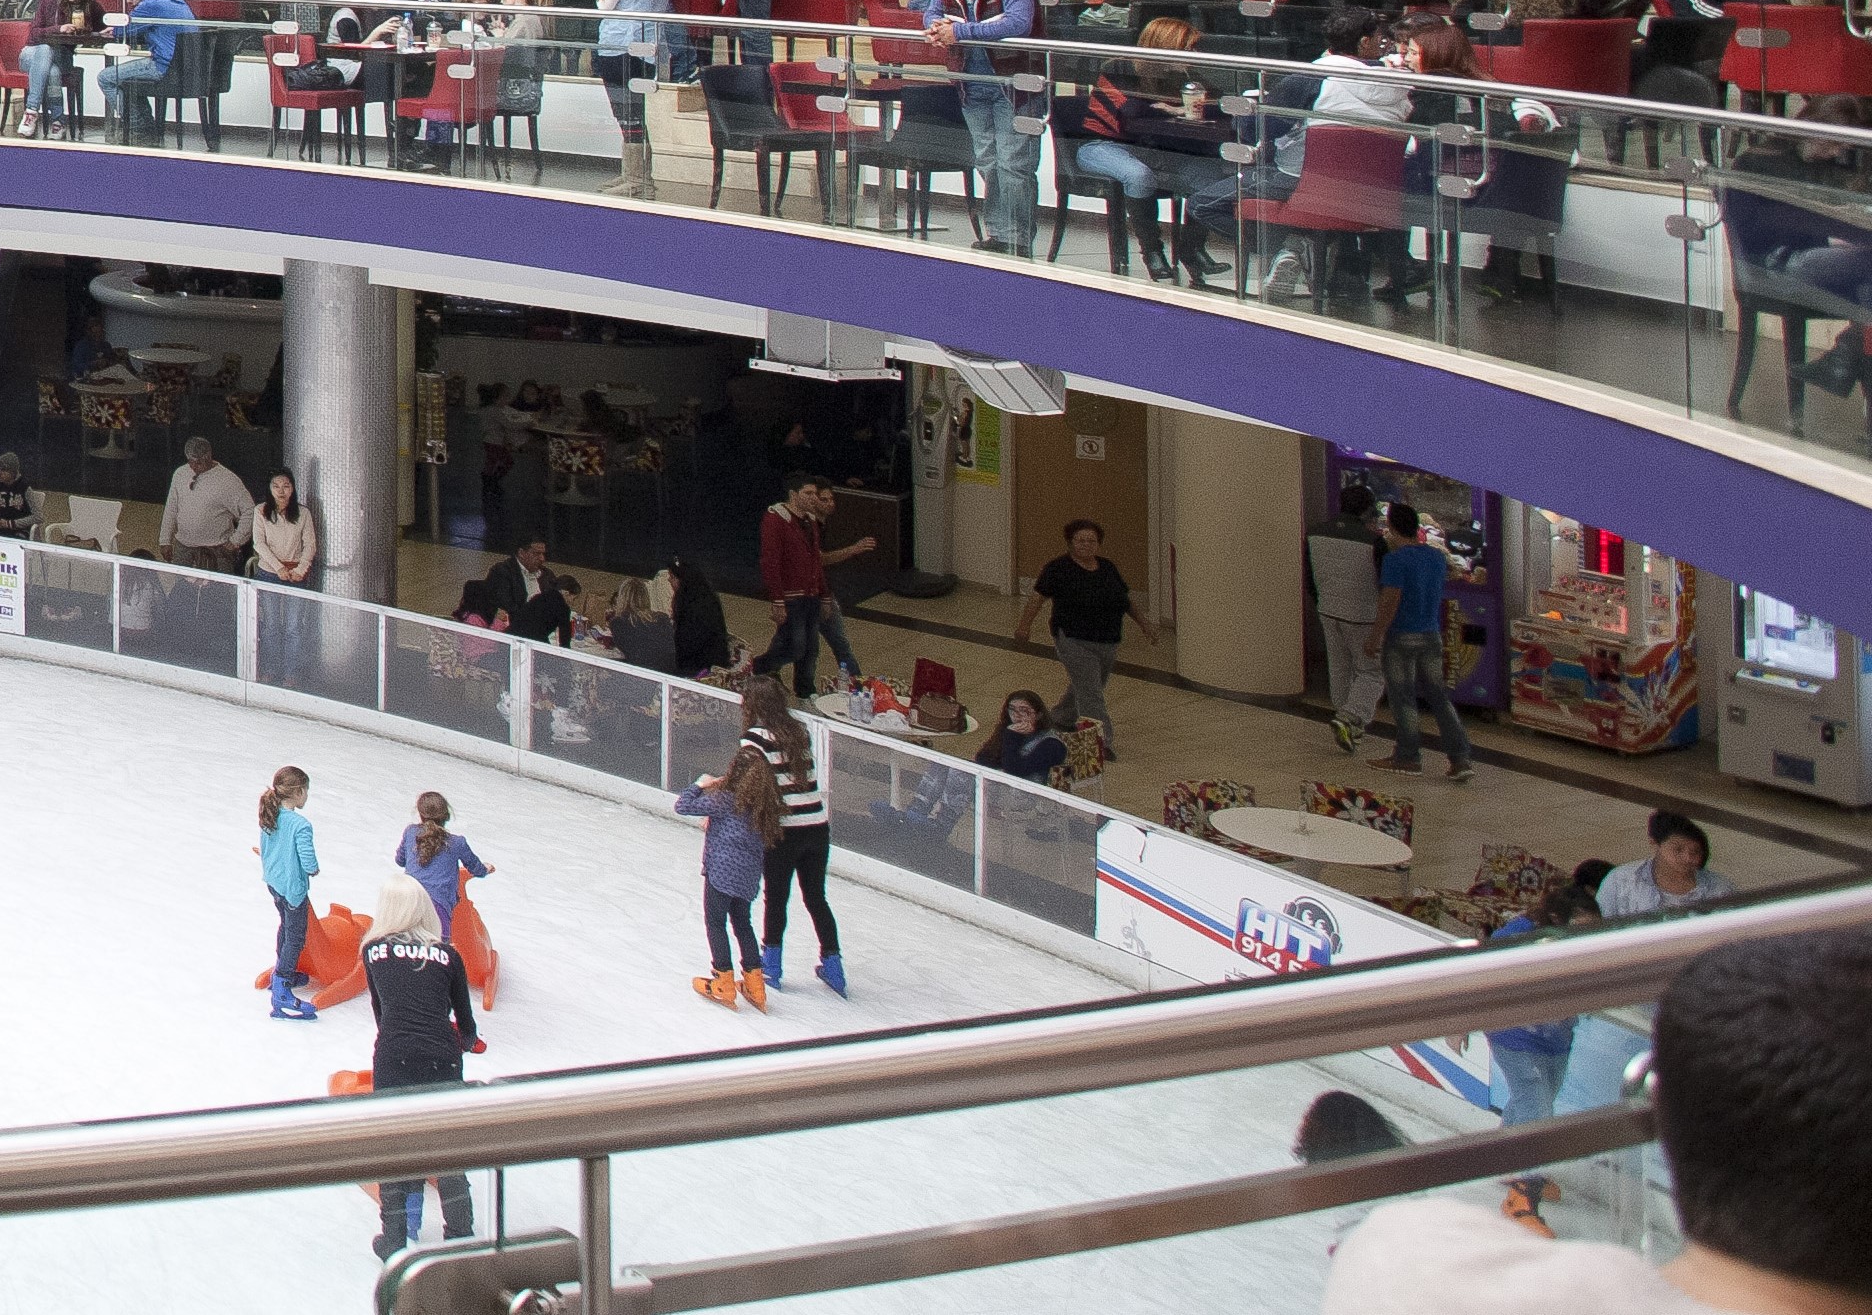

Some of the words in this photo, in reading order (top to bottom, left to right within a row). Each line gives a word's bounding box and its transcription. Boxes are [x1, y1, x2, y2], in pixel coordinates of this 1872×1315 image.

[1, 575, 17, 587] FM
[1243, 907, 1323, 963] HIT
[368, 944, 388, 964] ICE
[393, 944, 450, 966] GUARD
[1241, 936, 1281, 970] 91.4
